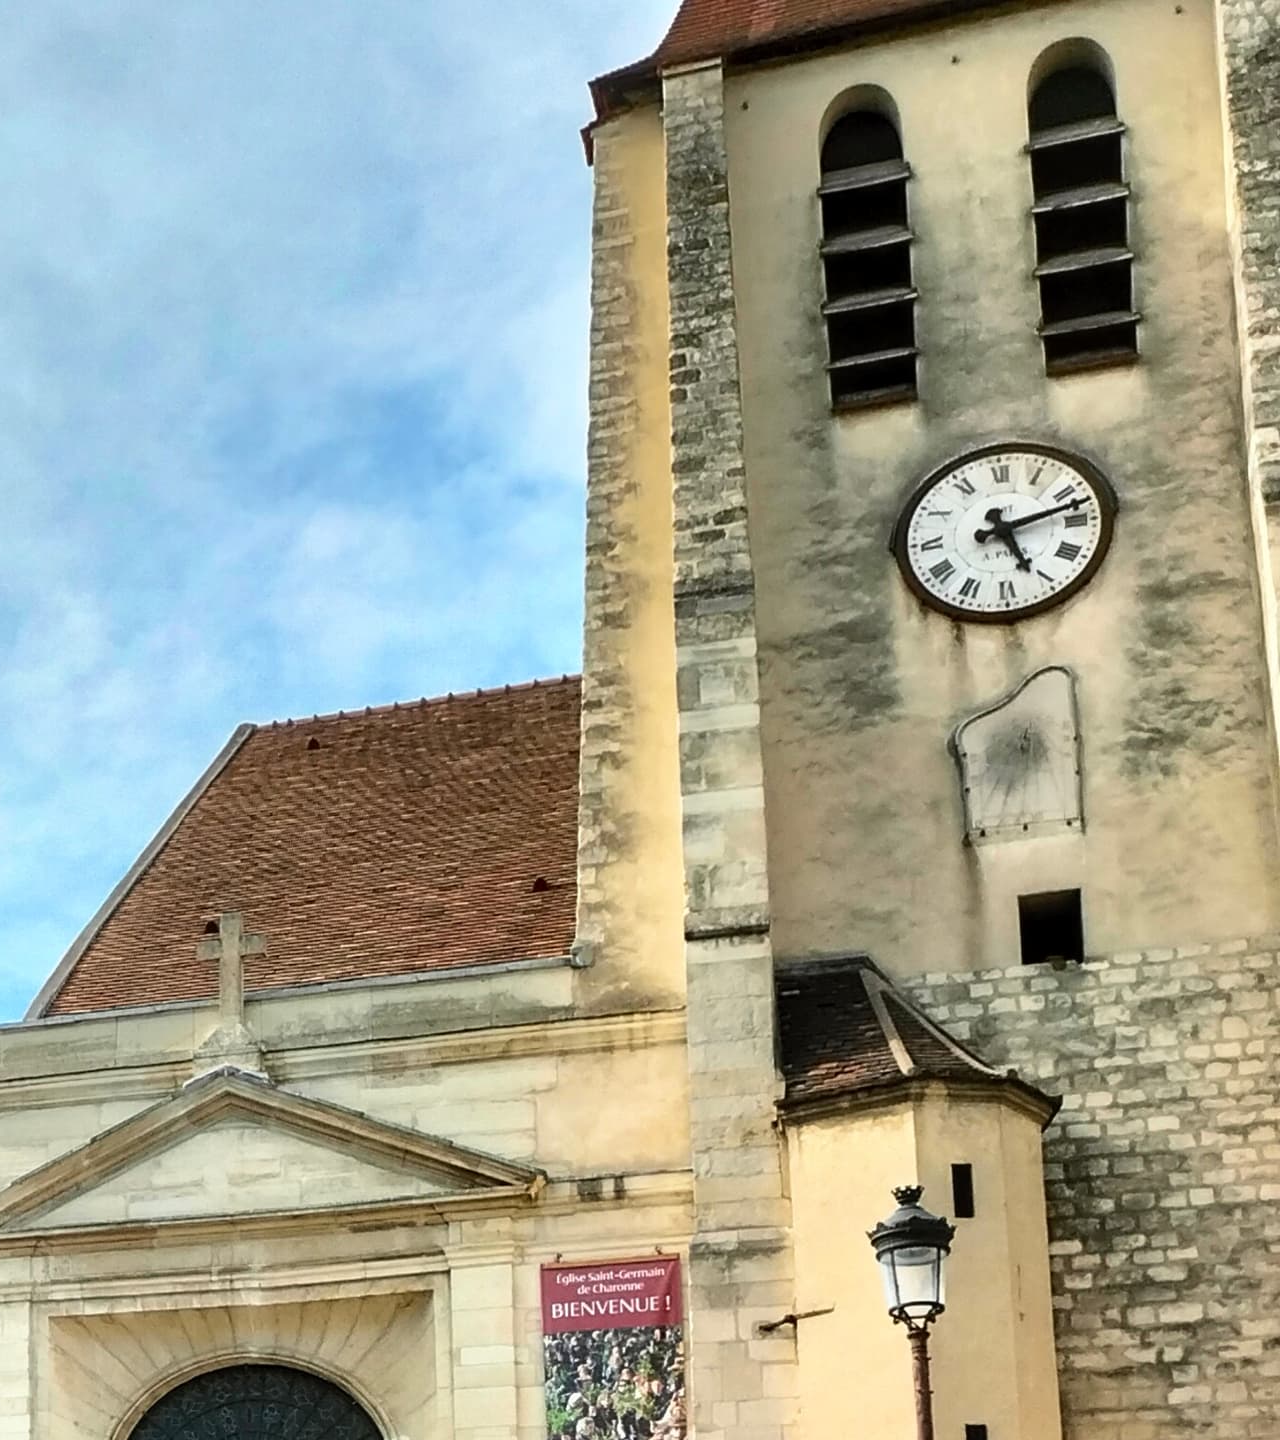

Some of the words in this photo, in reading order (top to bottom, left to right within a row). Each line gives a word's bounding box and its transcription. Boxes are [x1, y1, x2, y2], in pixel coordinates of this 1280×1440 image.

[587, 1266, 665, 1282] Saint-Germain
[577, 1284, 591, 1295] de
[592, 1281, 645, 1294] Charonne
[551, 1296, 660, 1319] BIENVENUE
[665, 1295, 671, 1311] !
